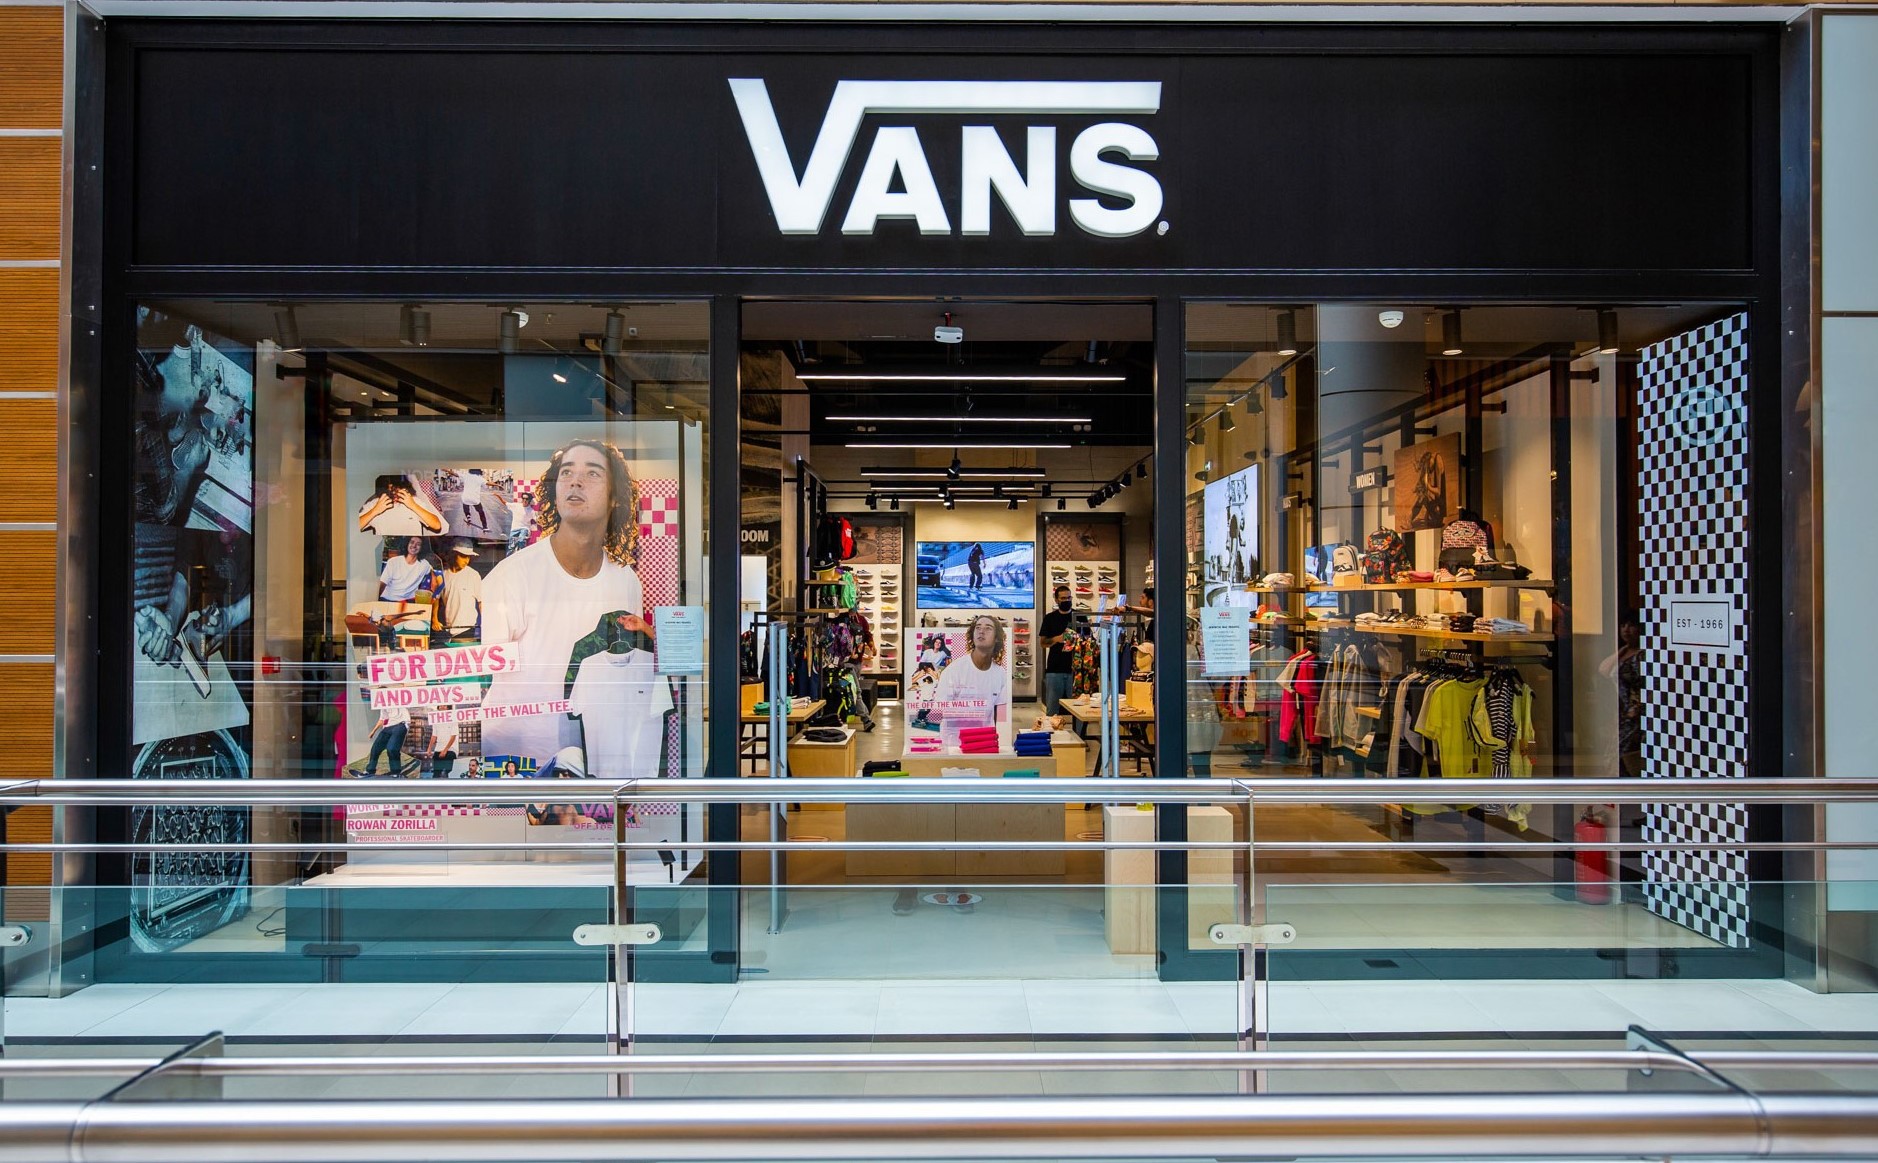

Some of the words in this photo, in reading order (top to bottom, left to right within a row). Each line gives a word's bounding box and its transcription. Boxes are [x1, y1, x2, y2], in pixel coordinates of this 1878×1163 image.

[728, 78, 1165, 236] VANS
[1356, 472, 1375, 489] WOMEN
[1677, 618, 1692, 628] EST
[1700, 619, 1723, 629] 1966
[371, 655, 427, 683] FOR
[434, 645, 515, 676] DAYS,
[373, 688, 413, 707] AND
[921, 701, 935, 709] OFF
[429, 711, 453, 724] THE
[456, 709, 479, 722] OFF
[484, 706, 507, 720] THE
[548, 701, 574, 713] TEE.
[347, 820, 387, 830] ROWAN
[391, 820, 435, 830] ZORILLA
